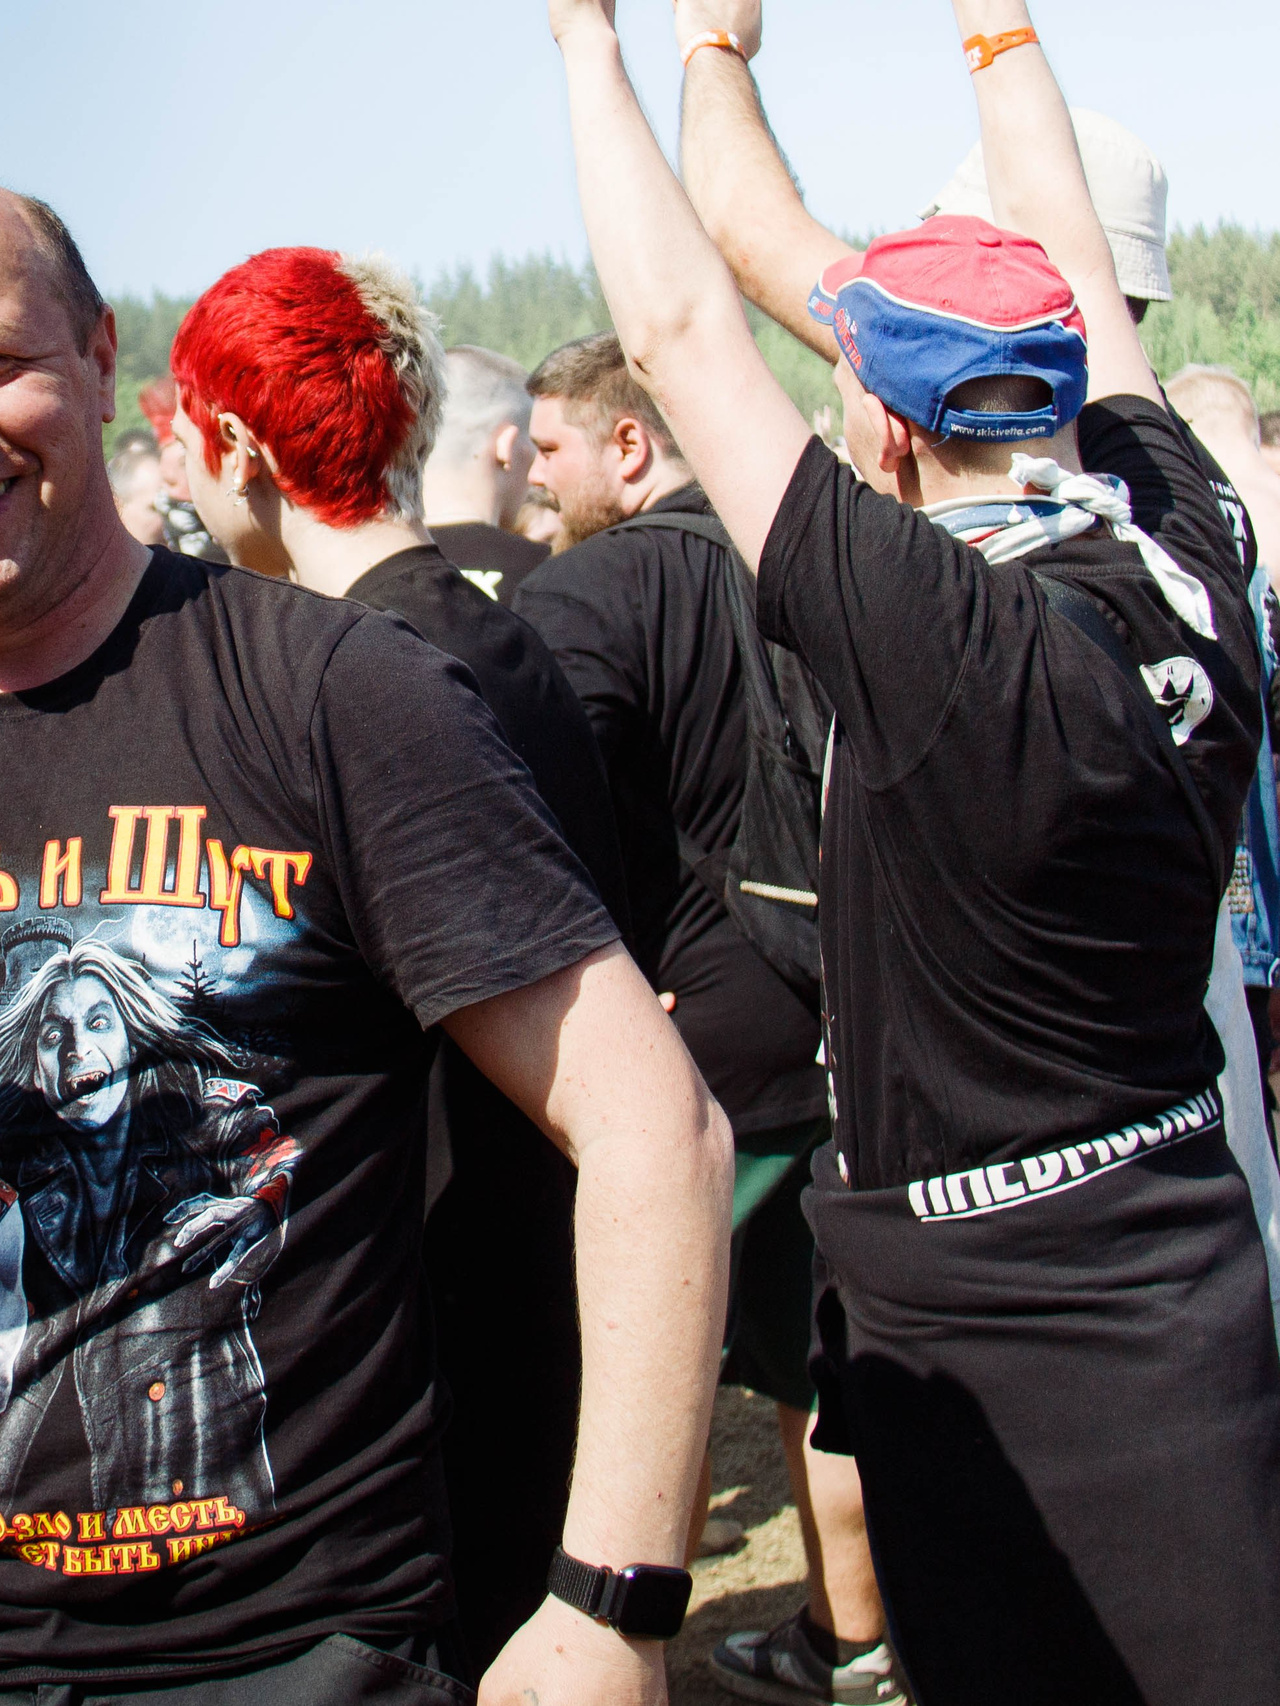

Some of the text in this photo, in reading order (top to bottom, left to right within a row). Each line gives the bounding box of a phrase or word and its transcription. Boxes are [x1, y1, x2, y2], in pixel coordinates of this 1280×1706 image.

[834, 307, 863, 370] CIVETTA
[38, 836, 82, 909] и
[100, 805, 313, 948] Шут
[77, 1511, 106, 1542] И
[113, 1496, 246, 1538] МЕСТЬ,
[63, 1541, 160, 1576] БЫТЬ
